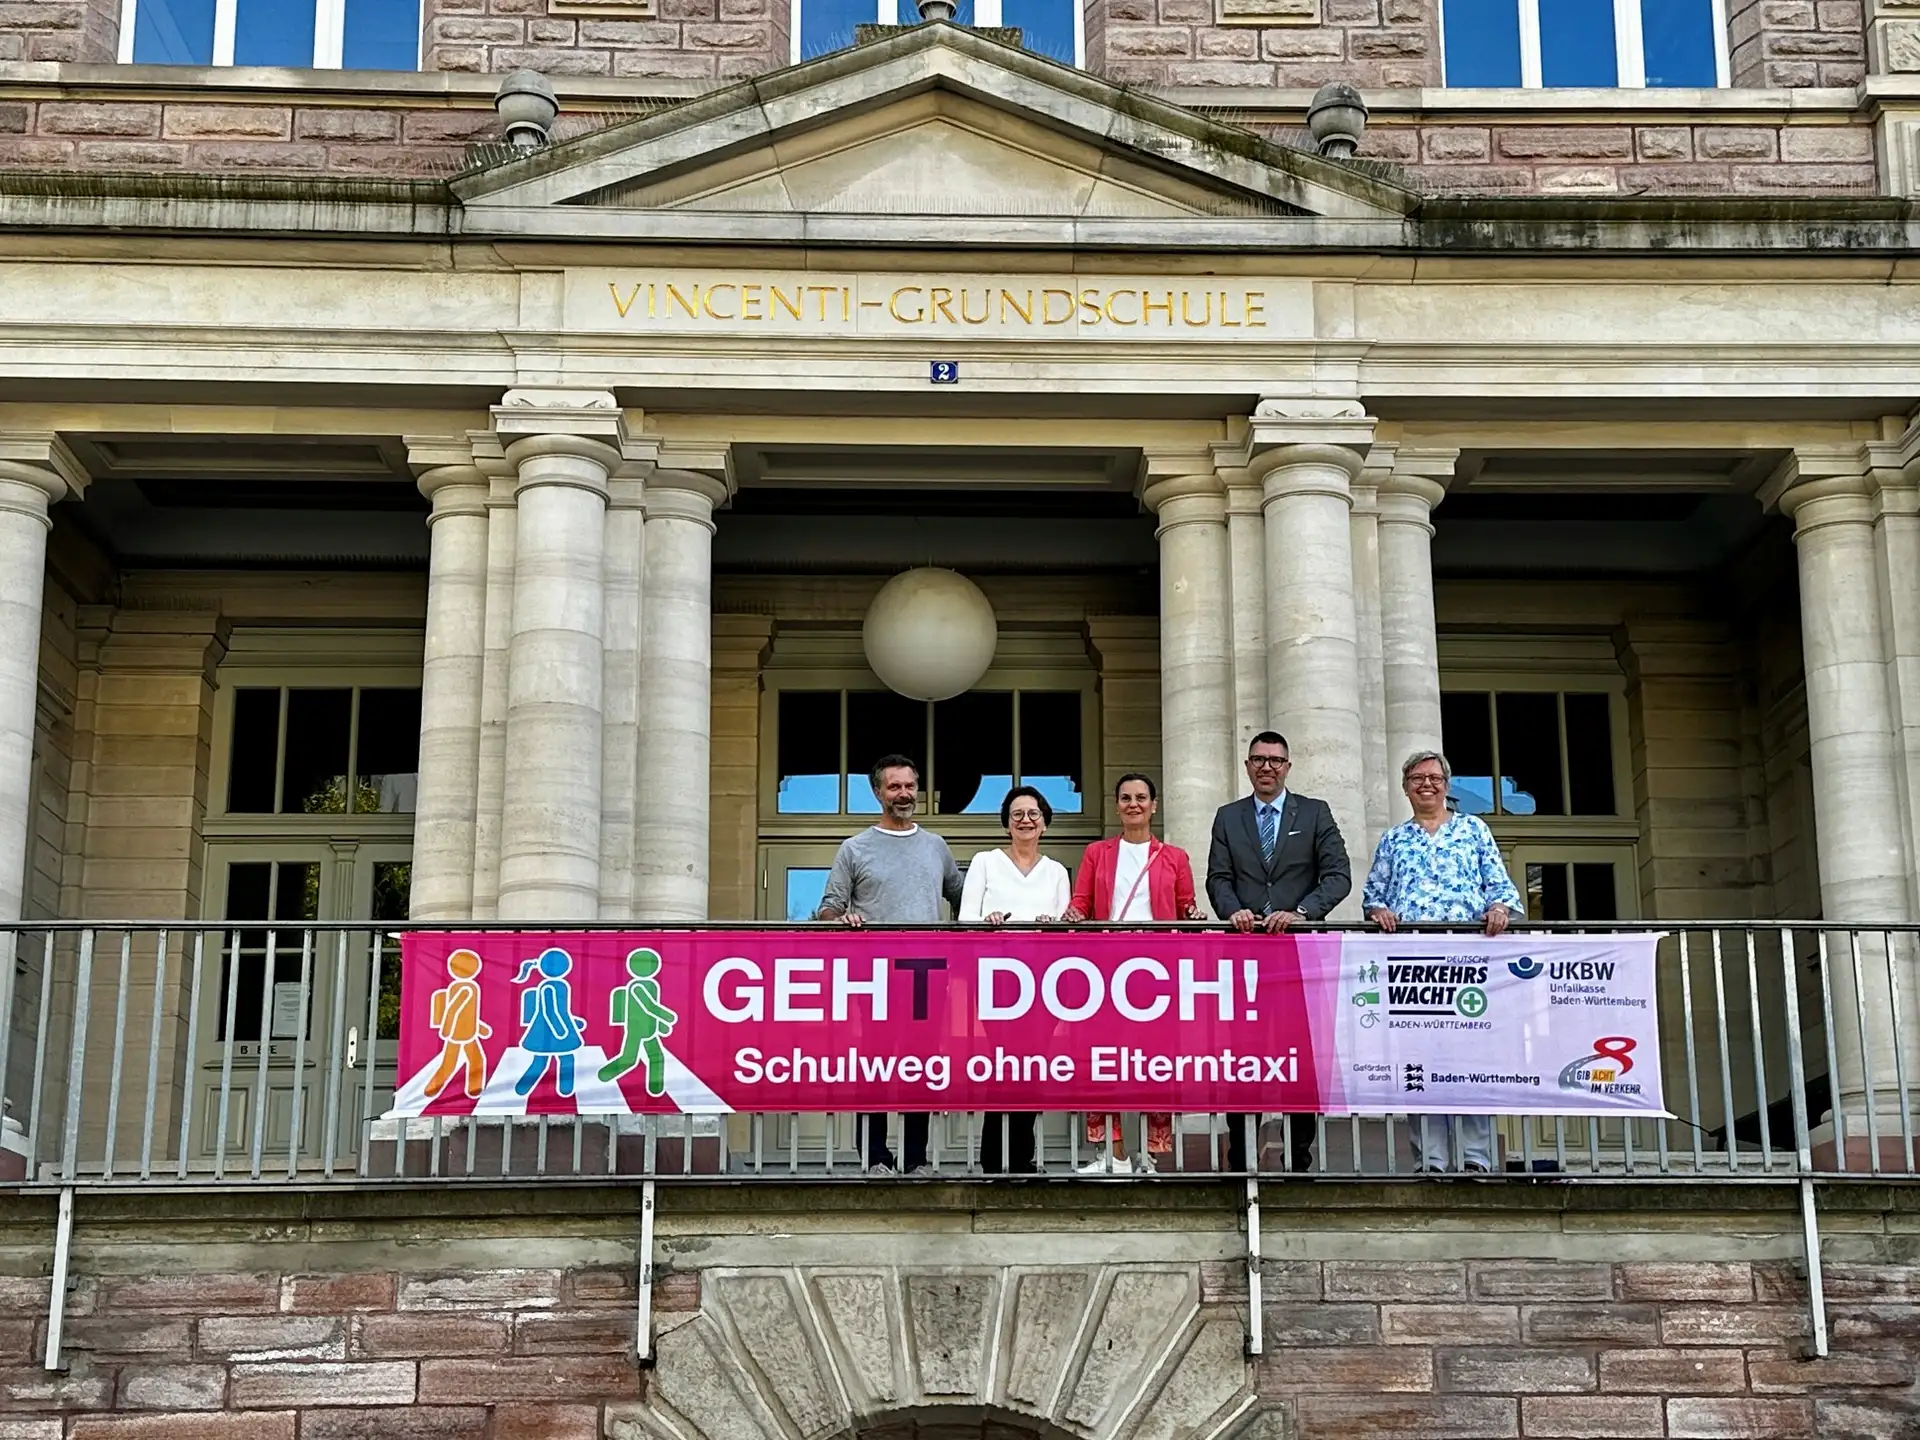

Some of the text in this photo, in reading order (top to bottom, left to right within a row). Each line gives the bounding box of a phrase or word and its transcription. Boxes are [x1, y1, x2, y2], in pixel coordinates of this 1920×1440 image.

[608, 282, 1268, 328] VINCENTI-GRUNDSCHULE
[938, 363, 950, 380] 2
[1446, 955, 1491, 964] DEUTSCHE
[1387, 965, 1488, 984] VERKEHRS
[1550, 962, 1615, 980] UKBW
[703, 957, 1259, 1022] GEHT DOCH!
[1550, 983, 1606, 993] Unfallkasse
[1387, 986, 1457, 1005] WACHT
[1551, 995, 1647, 1008] Baden-Württemberg
[1388, 1019, 1492, 1030] BADEN-WÜRTTEMBERG
[733, 1046, 1298, 1091] Schulweg ohne Elterntaxi
[1353, 1064, 1391, 1073] Gefördert
[1368, 1074, 1391, 1082] durch
[1431, 1073, 1541, 1086] Baden-Württemberg
[1576, 1070, 1615, 1081] GIB ACHT
[1590, 1083, 1641, 1094] IM VERKEHR
